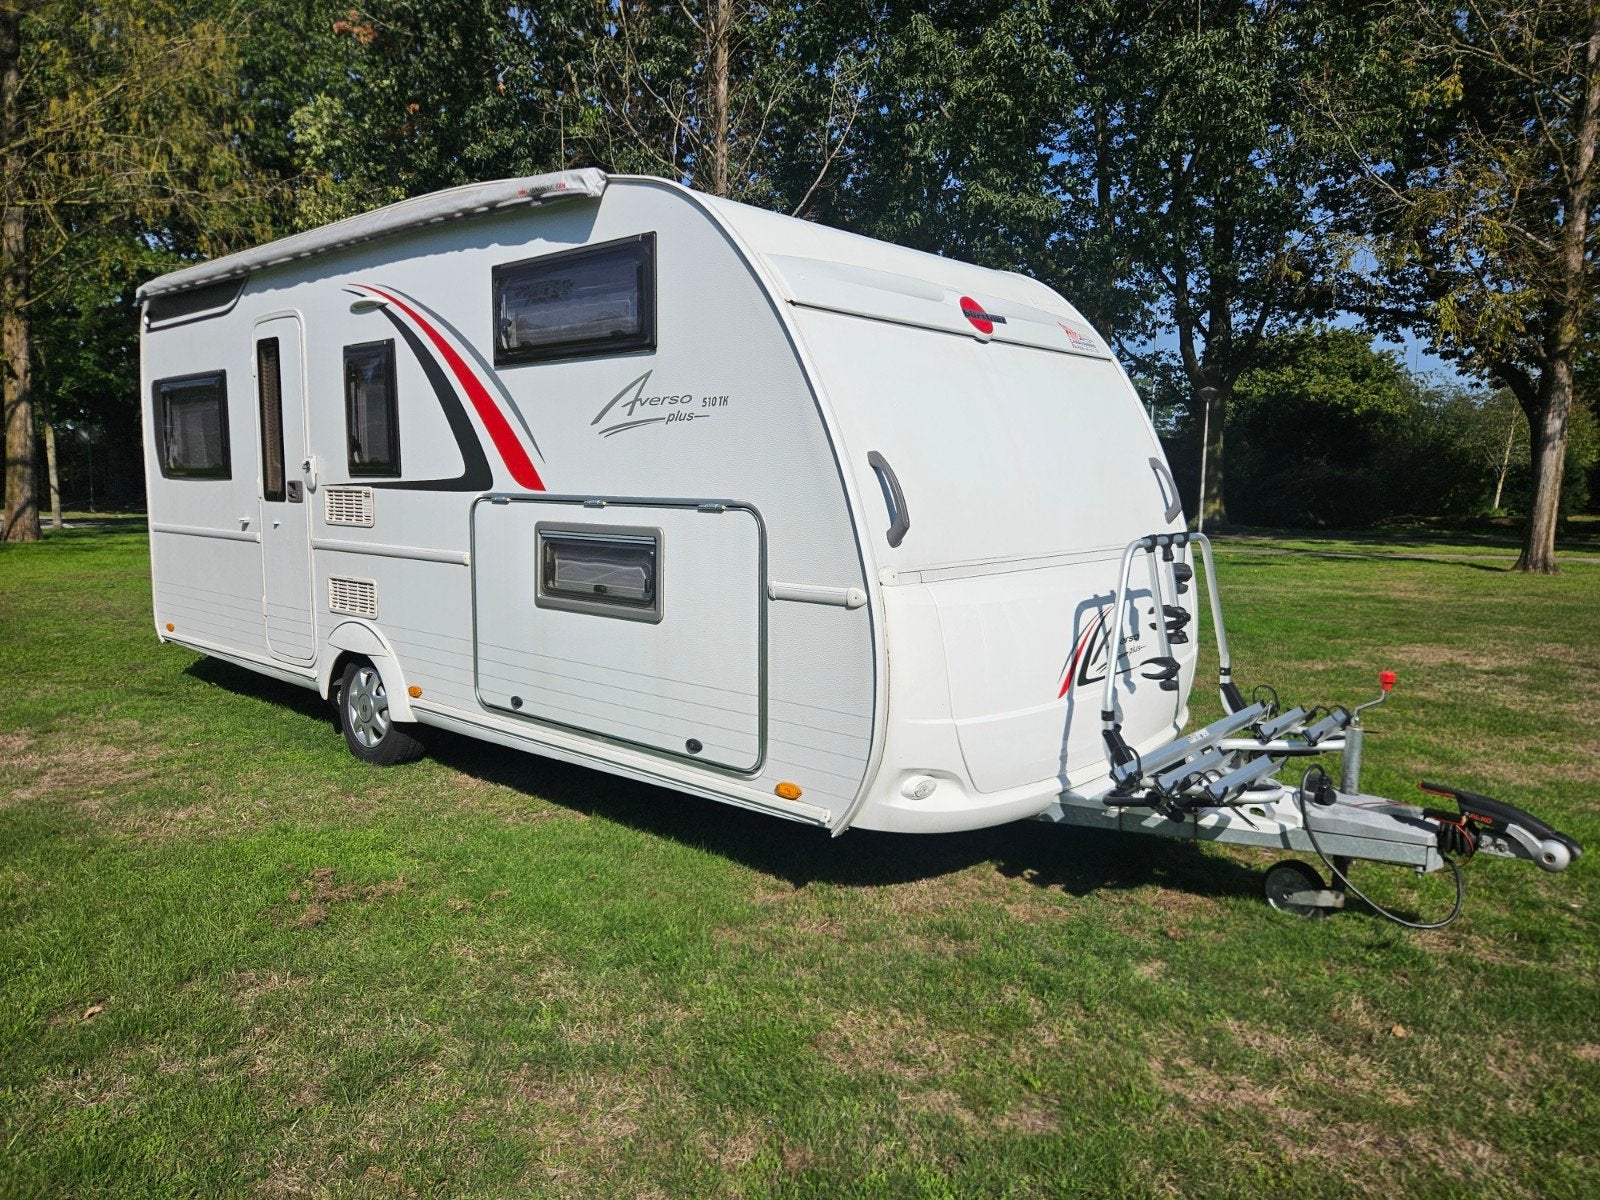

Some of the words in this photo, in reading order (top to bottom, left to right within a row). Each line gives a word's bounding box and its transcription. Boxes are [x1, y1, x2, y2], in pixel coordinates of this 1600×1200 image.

[590, 369, 693, 426] Averso
[701, 397, 717, 408] 510
[718, 396, 729, 406] TK
[665, 410, 695, 425] plus
